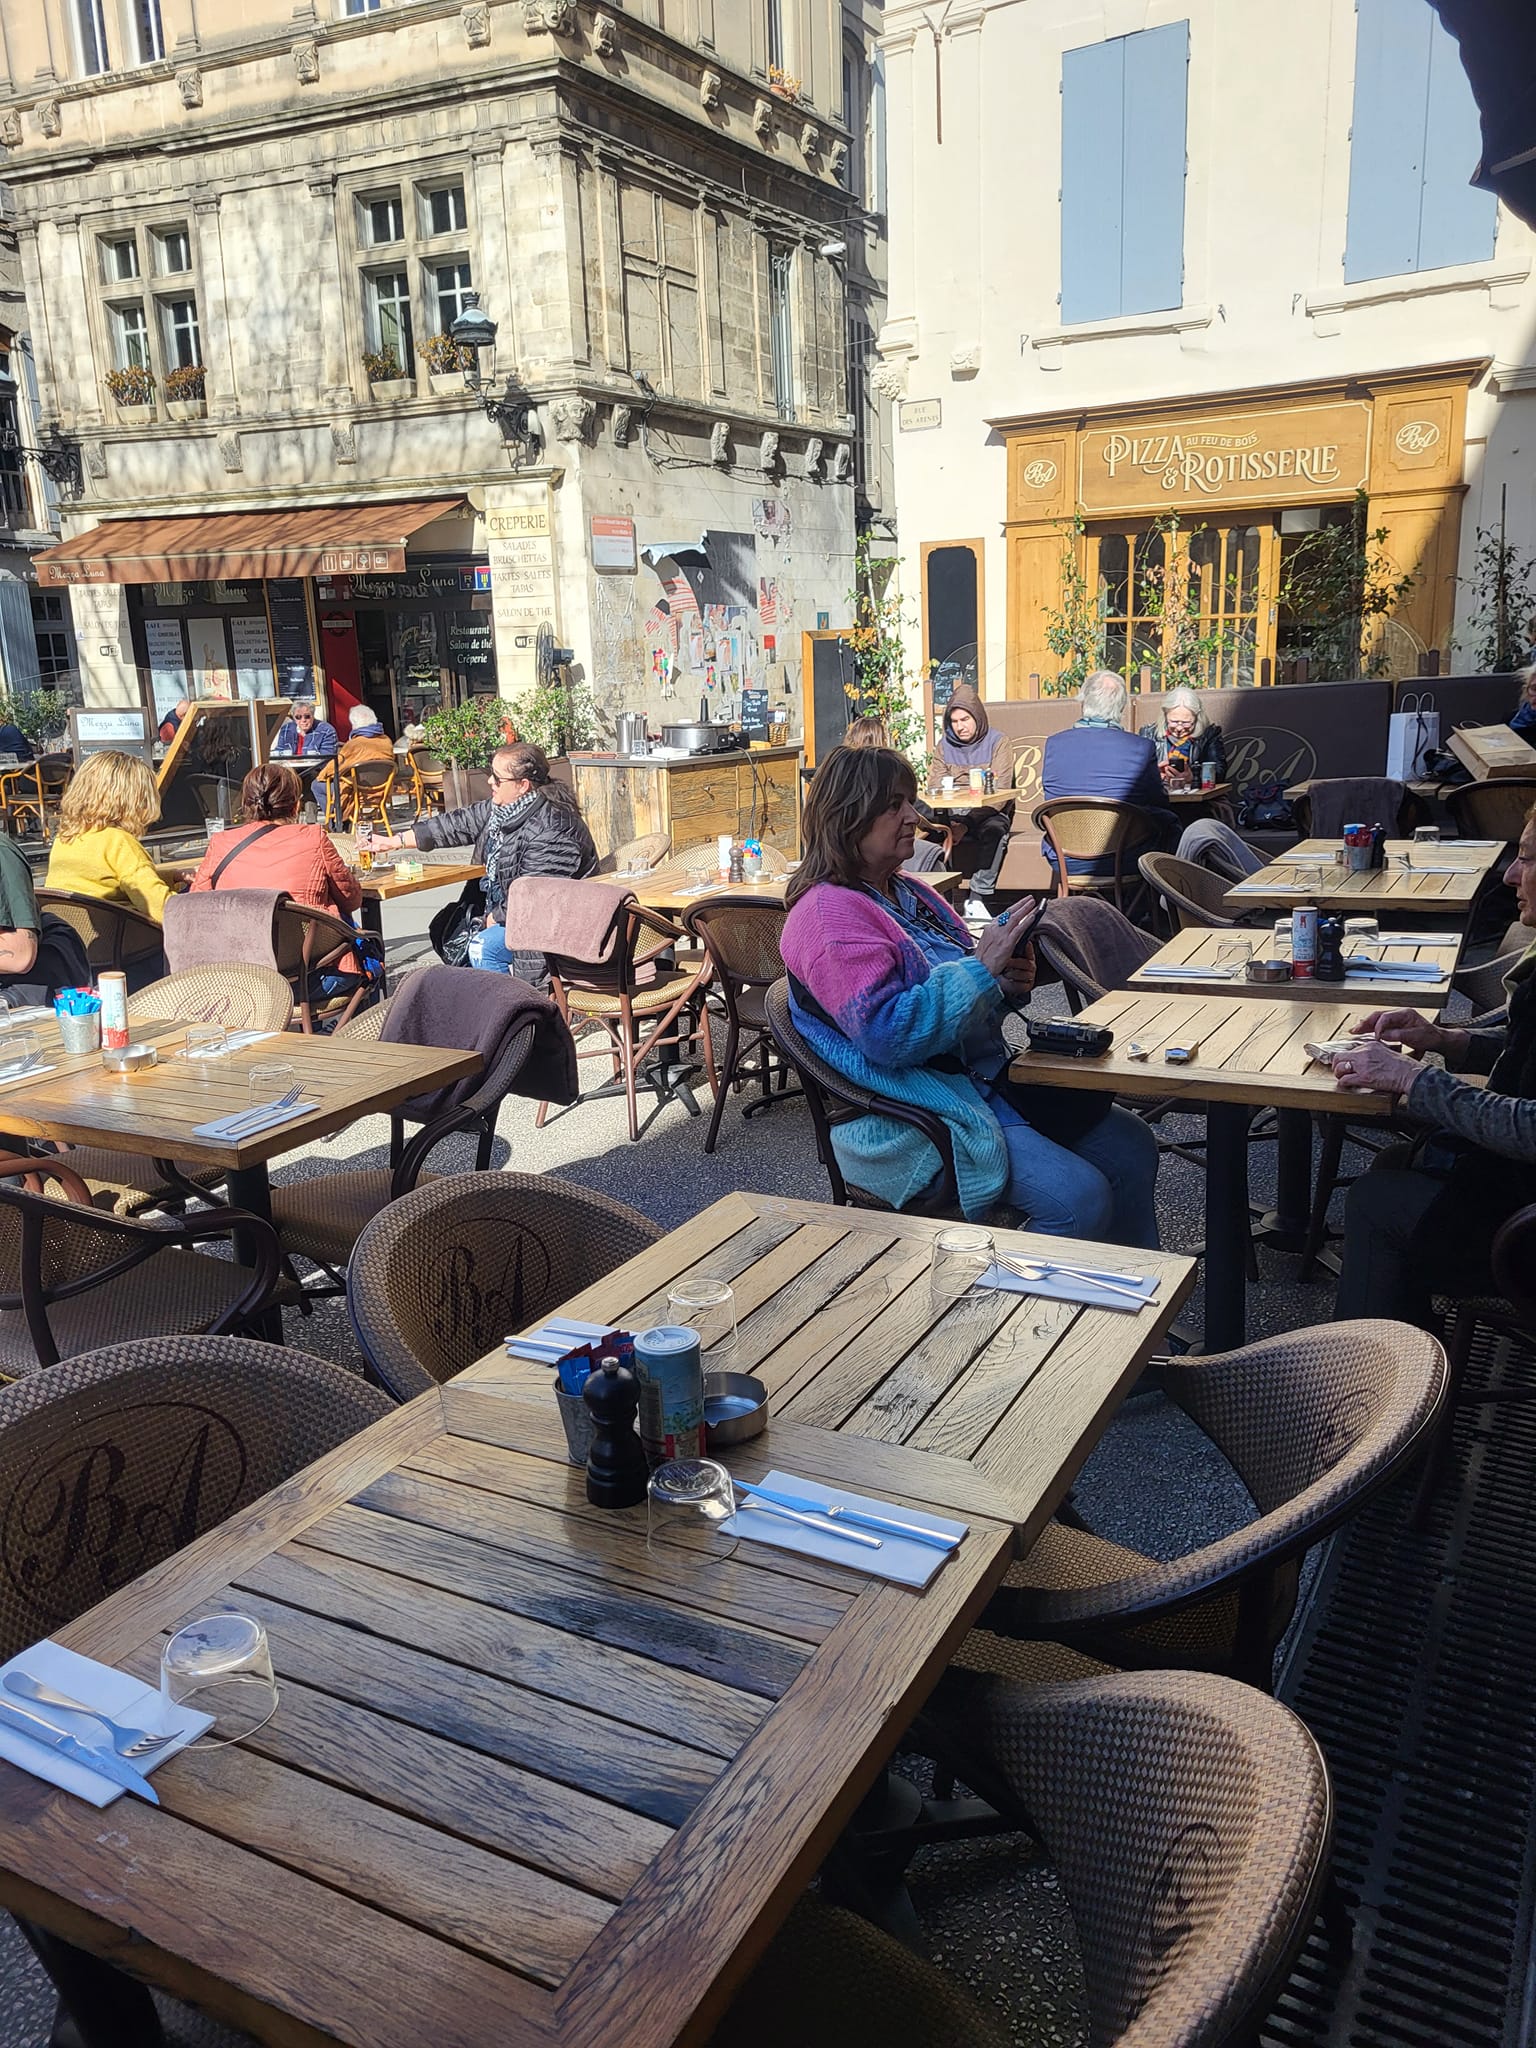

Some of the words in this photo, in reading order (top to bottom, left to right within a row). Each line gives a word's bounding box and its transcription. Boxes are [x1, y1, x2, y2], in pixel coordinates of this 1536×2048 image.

[1186, 437, 1198, 446] AU
[1201, 436, 1217, 446] FEU
[1220, 437, 1232, 447] DE
[1235, 433, 1258, 447] BOIS
[1102, 434, 1186, 477] PIZZA
[1161, 467, 1178, 490] &
[1180, 445, 1340, 493] ROTISSERIE
[489, 514, 546, 531] CREPERIE
[502, 540, 537, 551] SALADES
[450, 625, 490, 636] Restaurant
[450, 639, 469, 650] Salon
[471, 638, 480, 649] de
[481, 638, 493, 649] thé
